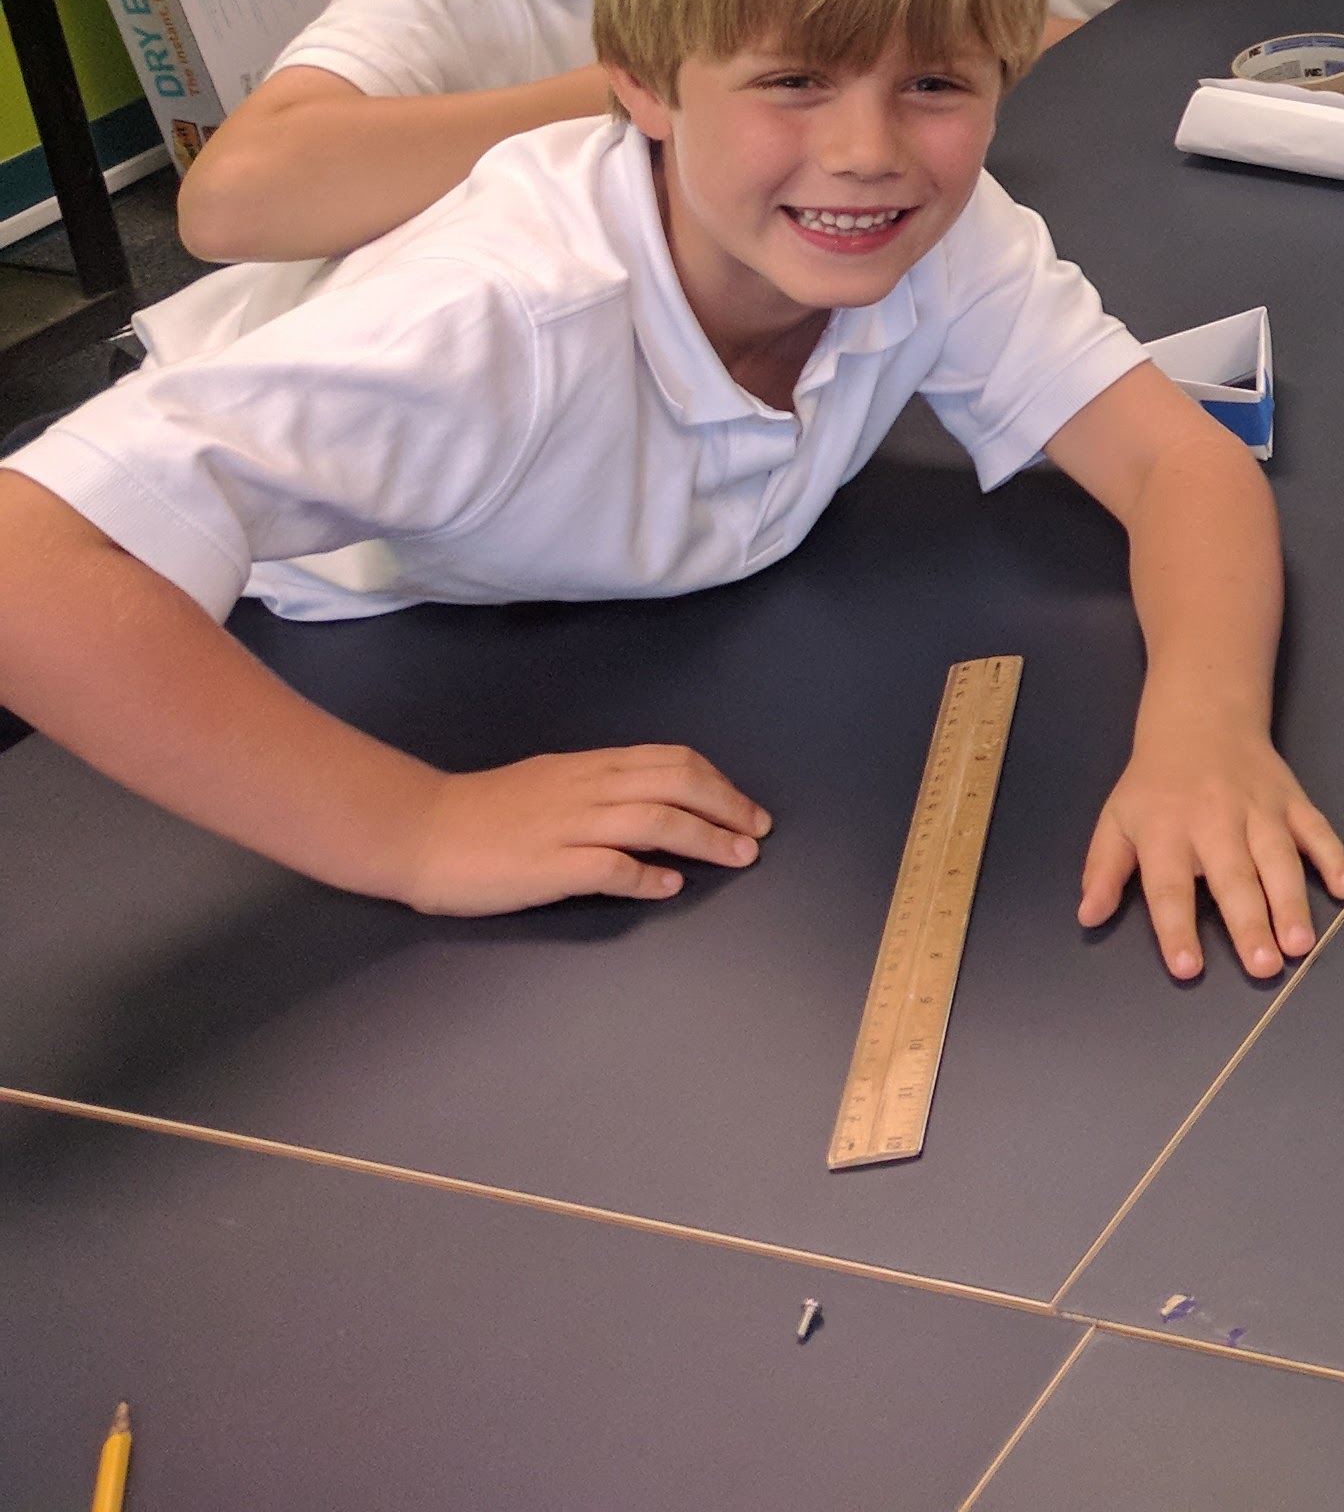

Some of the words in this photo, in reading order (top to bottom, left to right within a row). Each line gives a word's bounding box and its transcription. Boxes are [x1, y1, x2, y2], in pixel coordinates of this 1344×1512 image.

[132, 27, 187, 98] DRY
[1304, 68, 1323, 77] 3M
[185, 67, 200, 97] The
